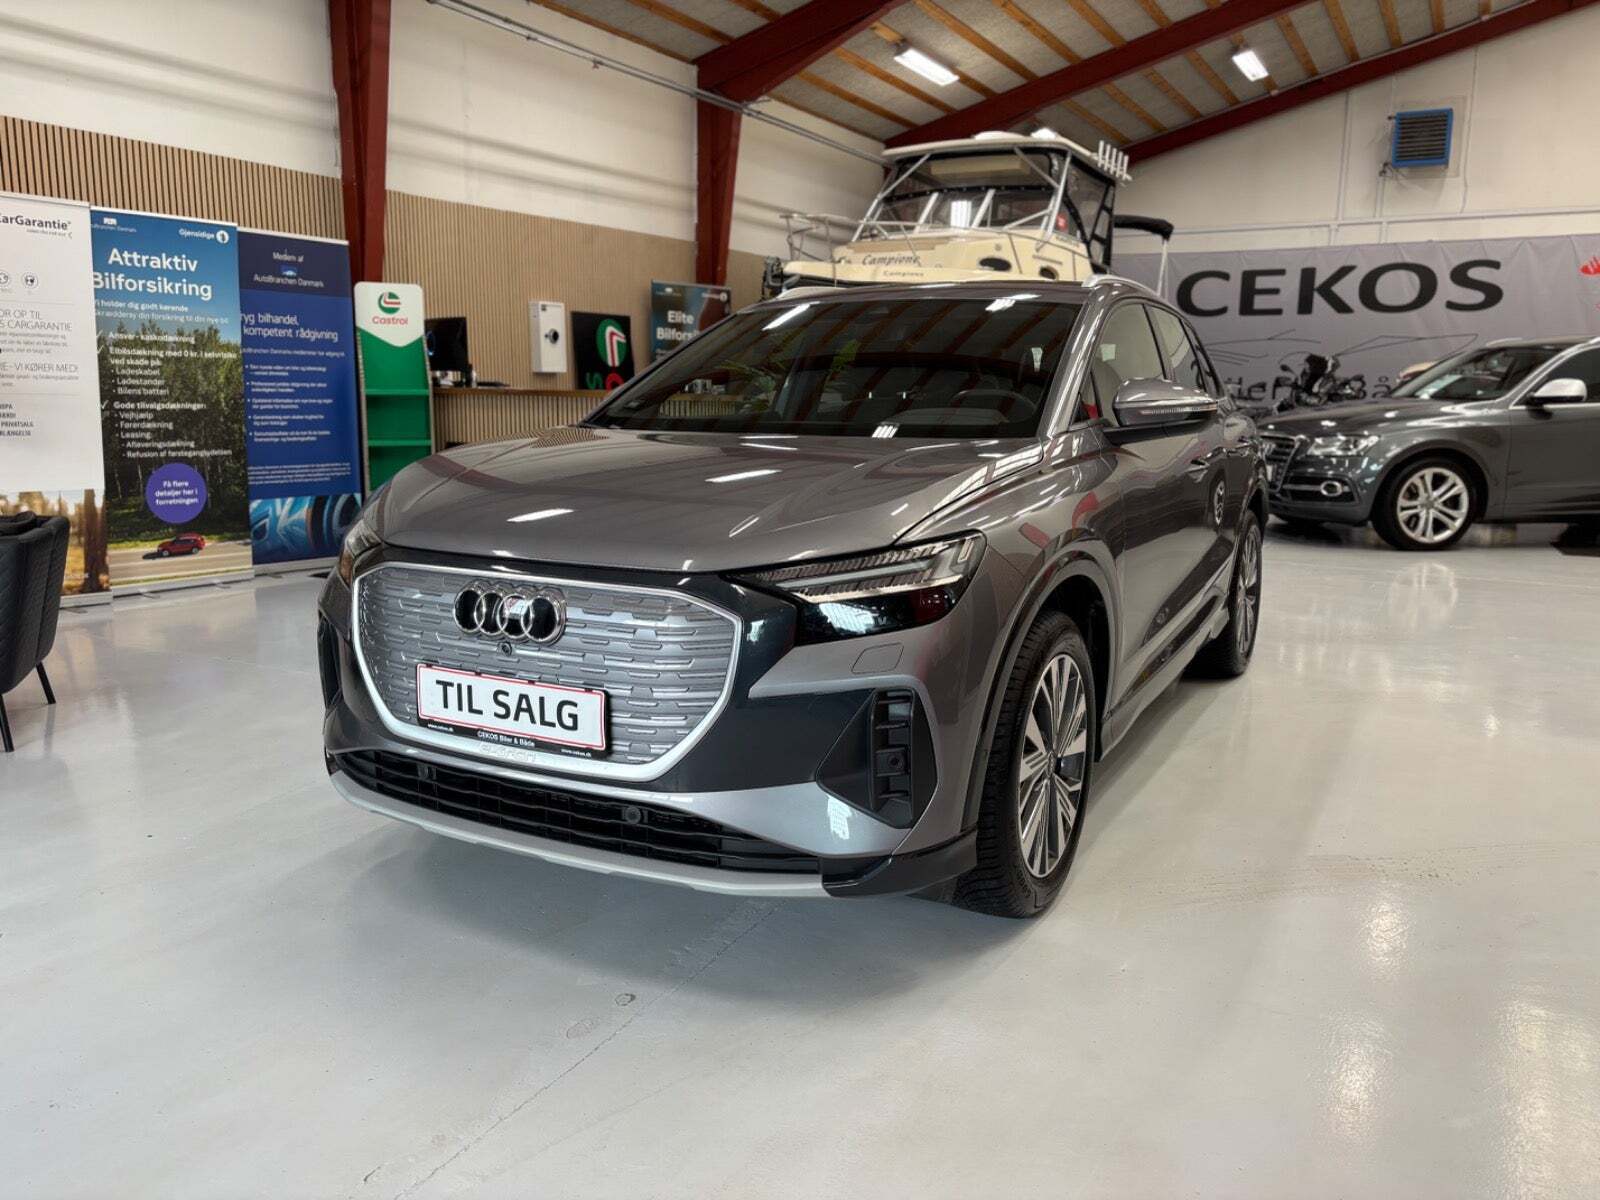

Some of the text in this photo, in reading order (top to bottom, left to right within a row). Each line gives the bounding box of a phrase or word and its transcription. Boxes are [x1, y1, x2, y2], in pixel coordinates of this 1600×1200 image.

[0, 214, 68, 230] arGarantie
[179, 228, 214, 239] Gjensidige
[108, 247, 198, 272] Attraktiv
[93, 271, 212, 301] Bilforsikring
[298, 278, 324, 288] Danmark
[1176, 259, 1504, 317] CEKOS
[372, 315, 408, 325] Castrol
[667, 310, 694, 324] Elite
[7, 321, 72, 332] CARGARANTIE
[243, 325, 339, 343] kompetent rådgivning
[165, 350, 182, 358] med
[110, 357, 125, 365] ved
[116, 367, 160, 375] Ladeskabel
[118, 387, 169, 395] Bilens batteri
[113, 401, 135, 409] Gode
[120, 411, 153, 421] Vejhjælp
[155, 489, 181, 498] detaljer
[435, 679, 579, 731] TIL SALG
[477, 730, 535, 748] CEKOS Biler & Både
